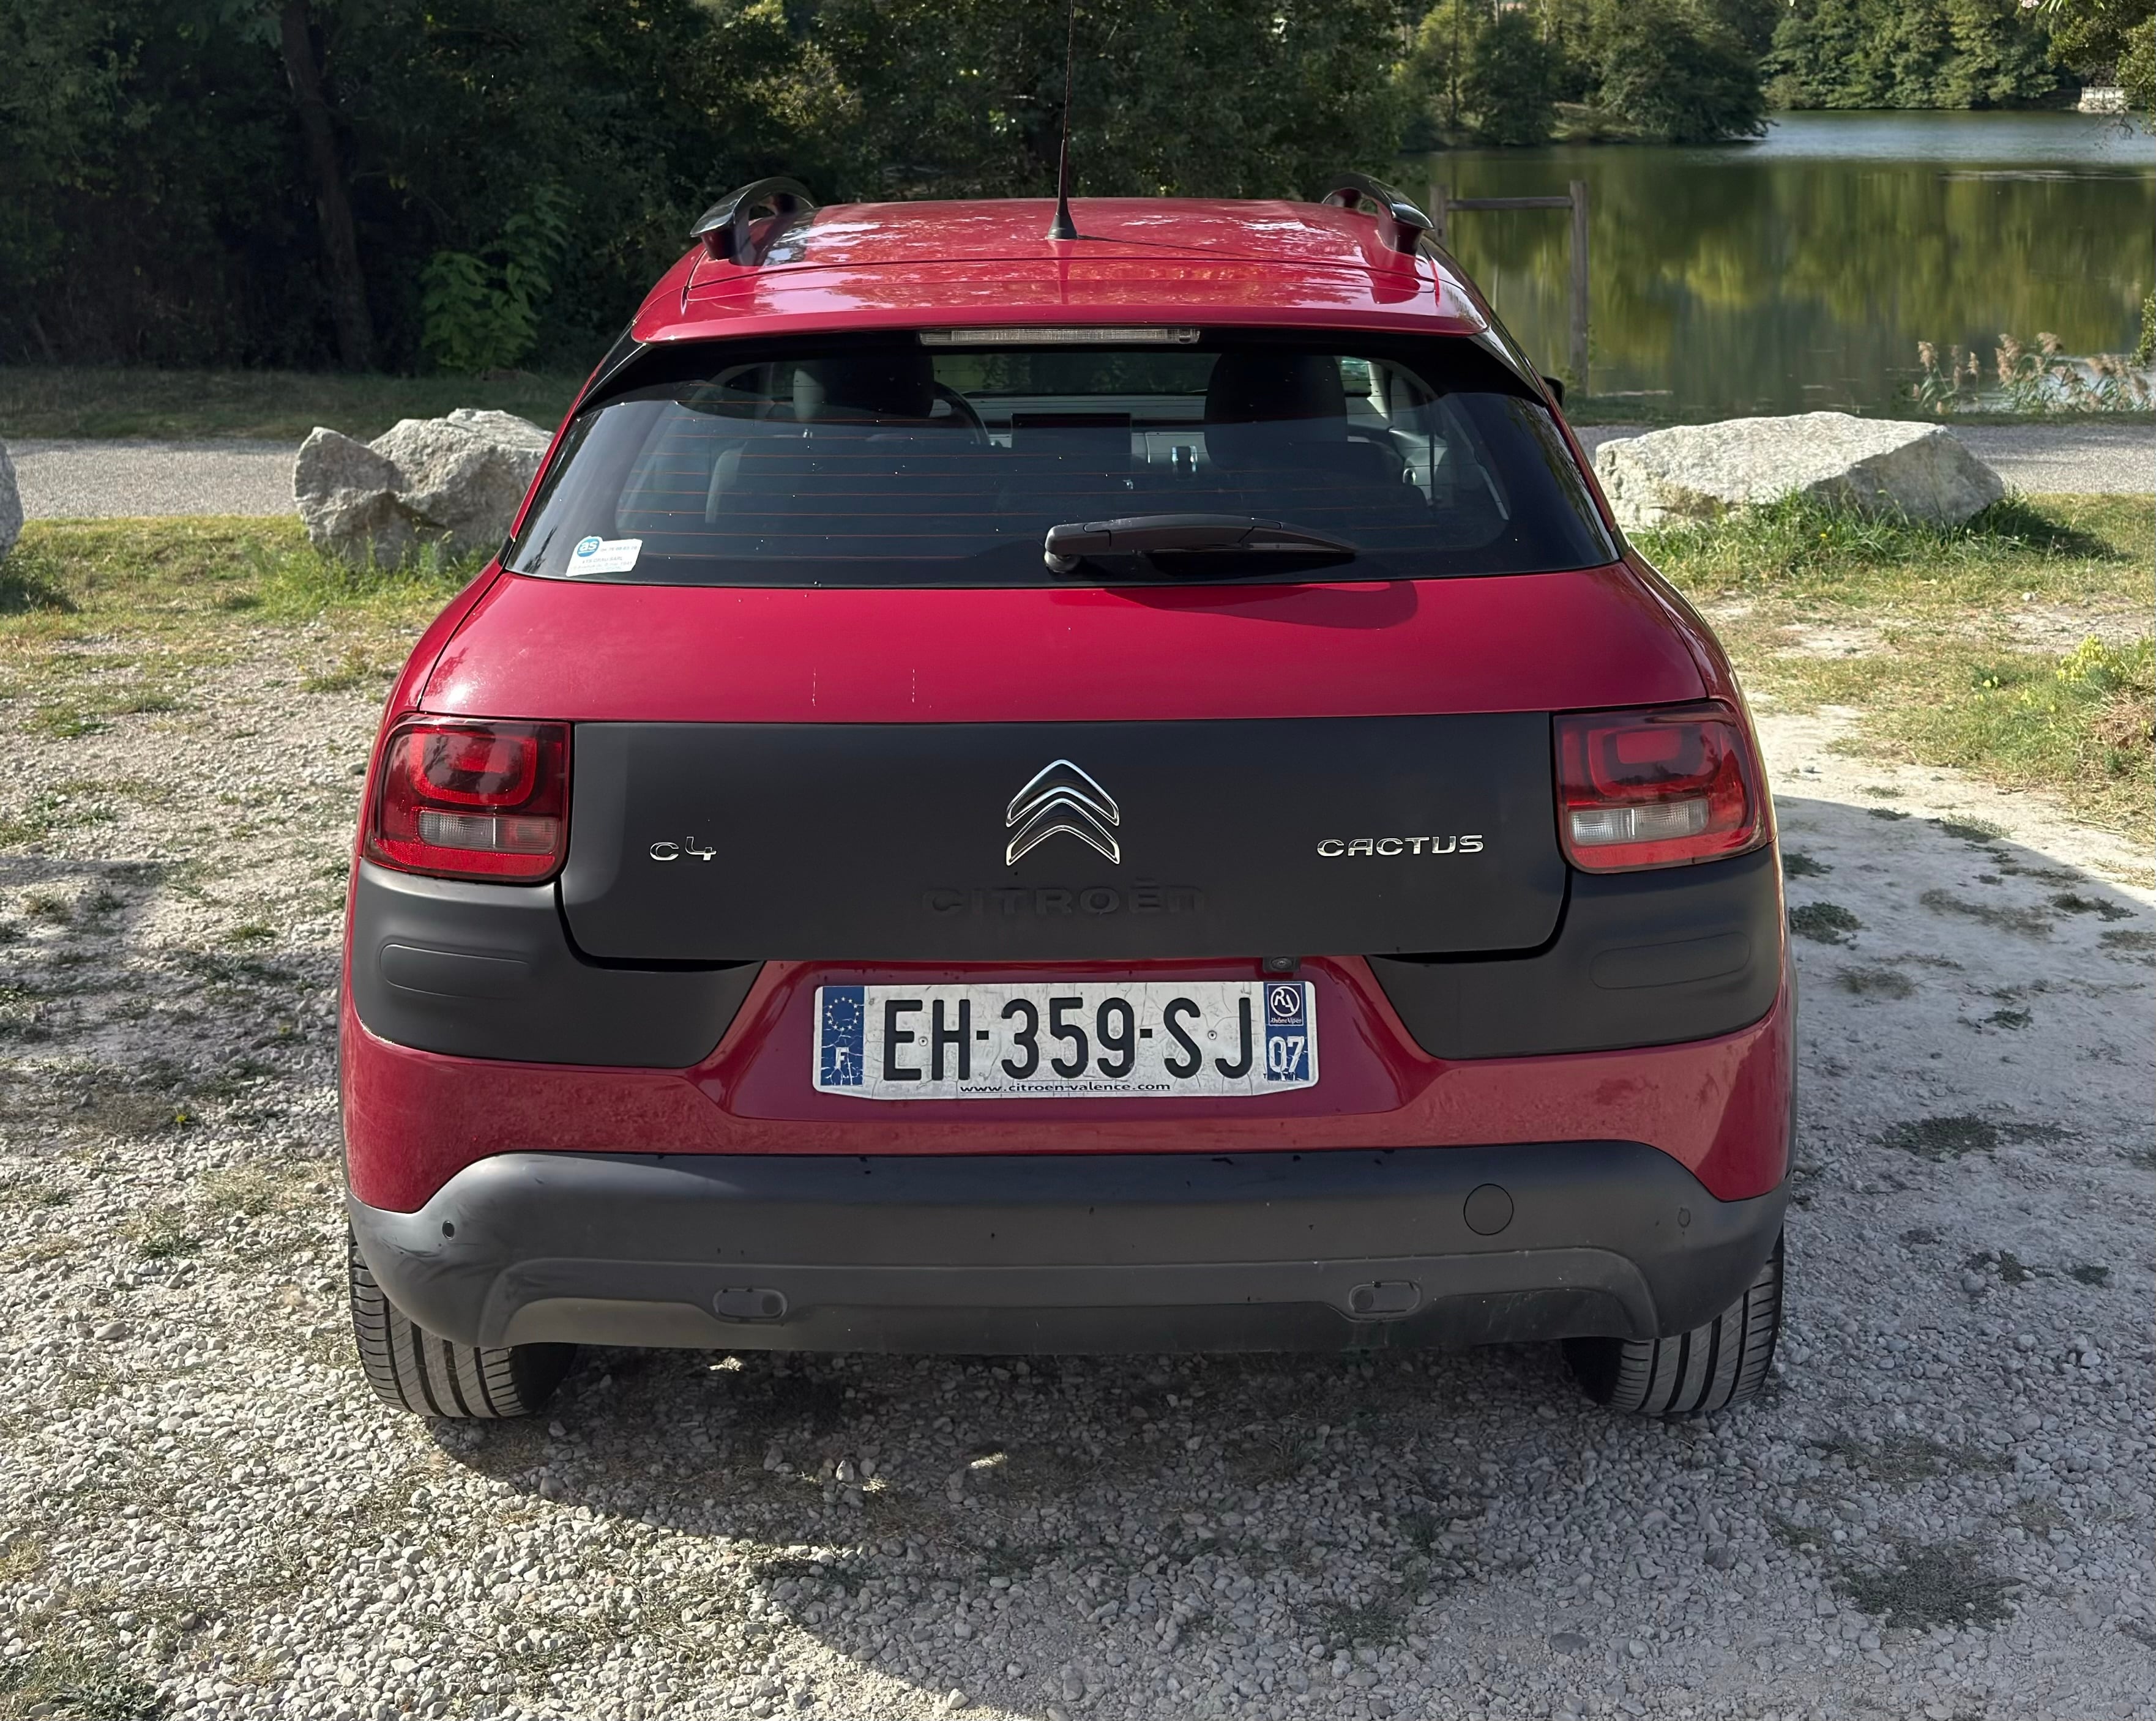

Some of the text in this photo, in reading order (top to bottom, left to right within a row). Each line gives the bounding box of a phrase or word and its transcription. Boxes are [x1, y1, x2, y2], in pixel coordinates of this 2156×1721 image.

[579, 541, 598, 551] as
[650, 836, 717, 861] C4
[1317, 834, 1483, 857] CACTUS
[922, 877, 1205, 916] CITROËN
[883, 997, 1253, 1081] EH-359-SJ
[835, 1047, 849, 1069] F
[1269, 1036, 1305, 1072] 07
[960, 1082, 1171, 1092] www.citroen-valence.com
